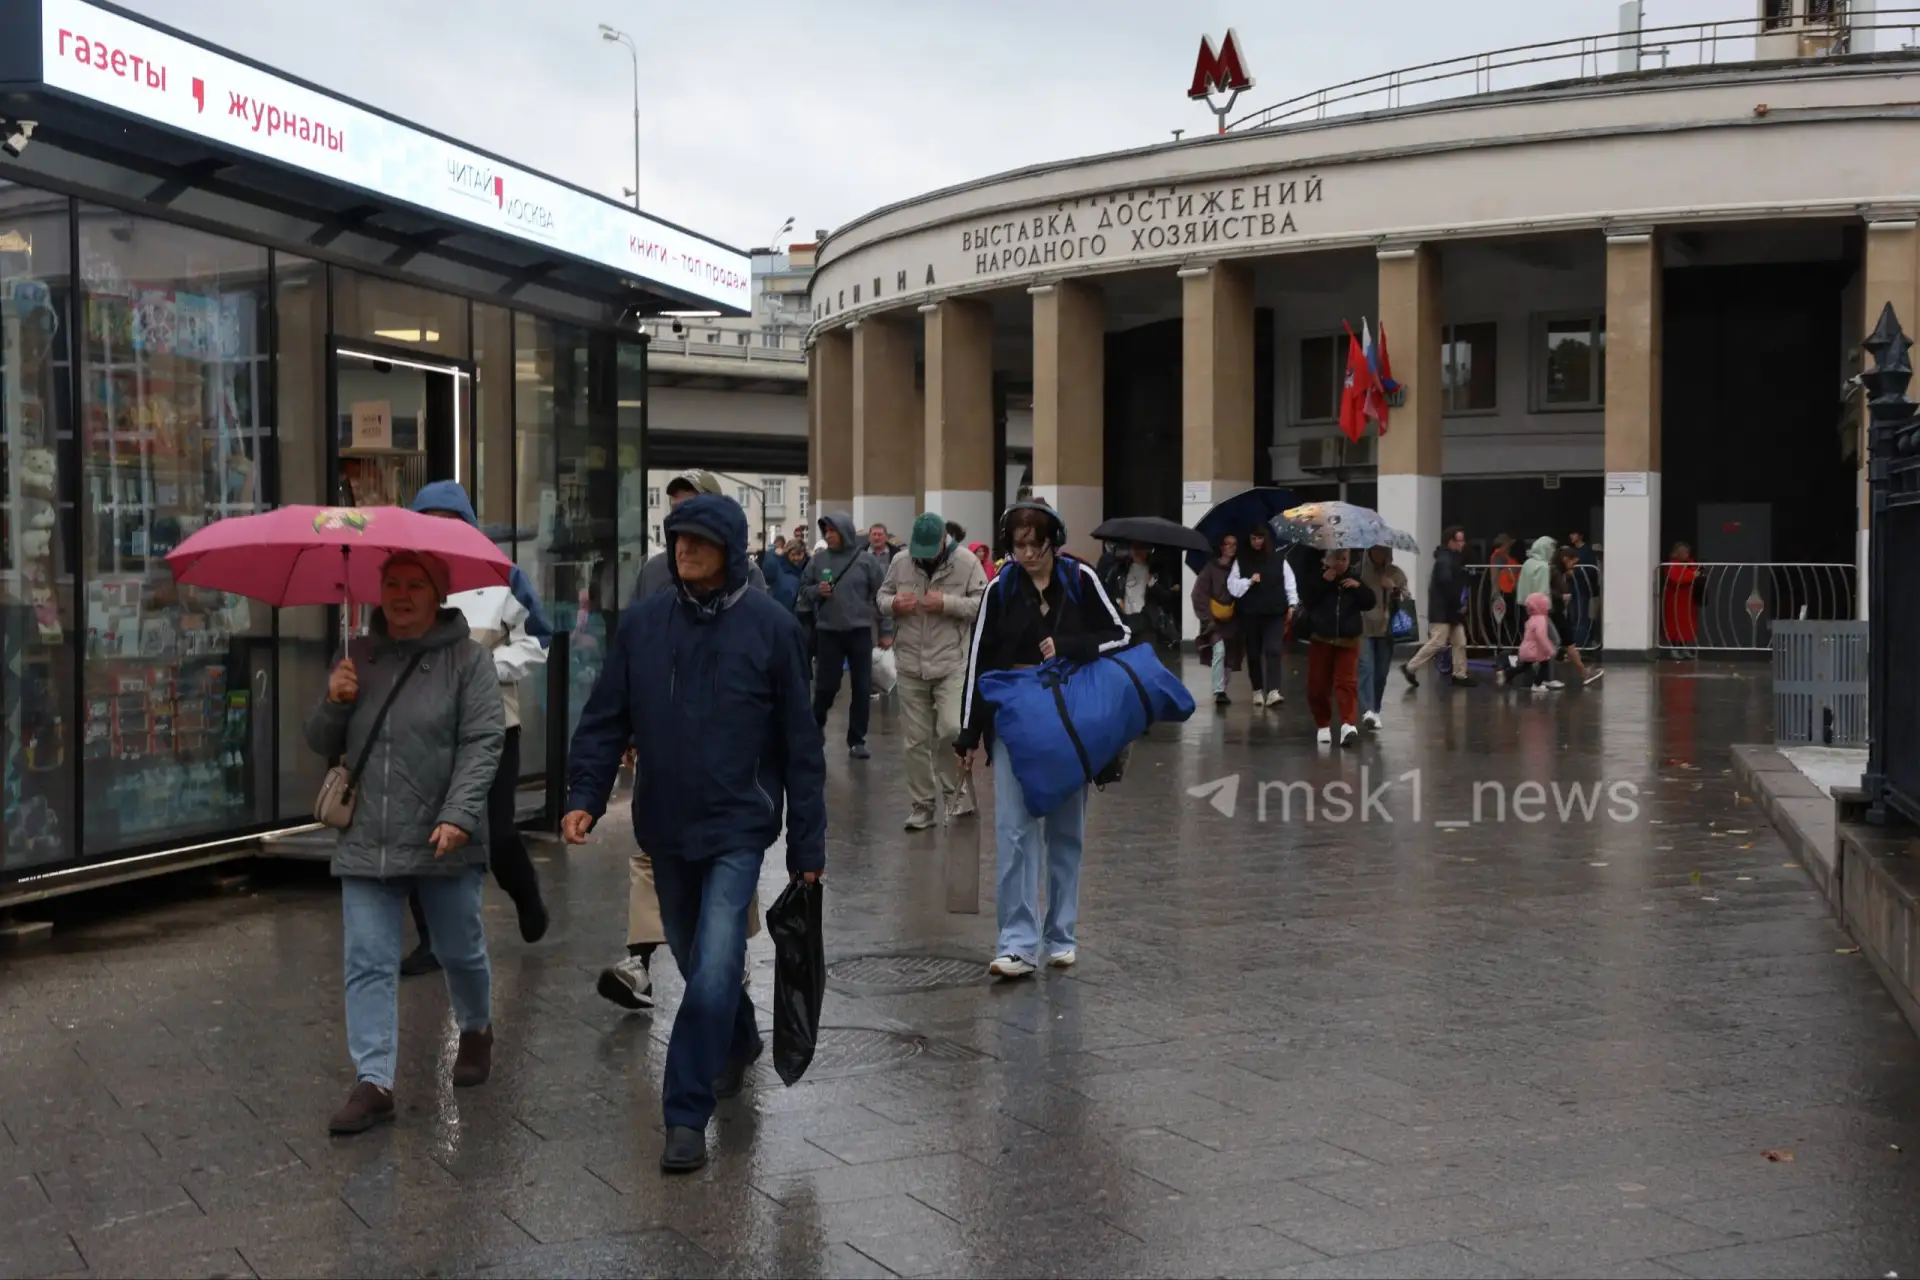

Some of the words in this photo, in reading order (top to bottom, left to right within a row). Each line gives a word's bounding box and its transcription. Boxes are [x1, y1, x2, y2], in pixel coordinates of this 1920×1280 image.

[58, 28, 166, 91] газеты
[228, 90, 344, 153] журналы
[447, 157, 493, 196] ЧИТАЙ
[962, 212, 1077, 253] ВЫСТАВКА
[1098, 174, 1324, 230] ДОСТИЖЕНИЙ
[975, 233, 1107, 274] НАРОДНОГО
[1131, 211, 1298, 252] ХОЗЯЙСТВА
[629, 234, 668, 265] книги
[681, 254, 701, 277] топ
[705, 262, 748, 292] продаж
